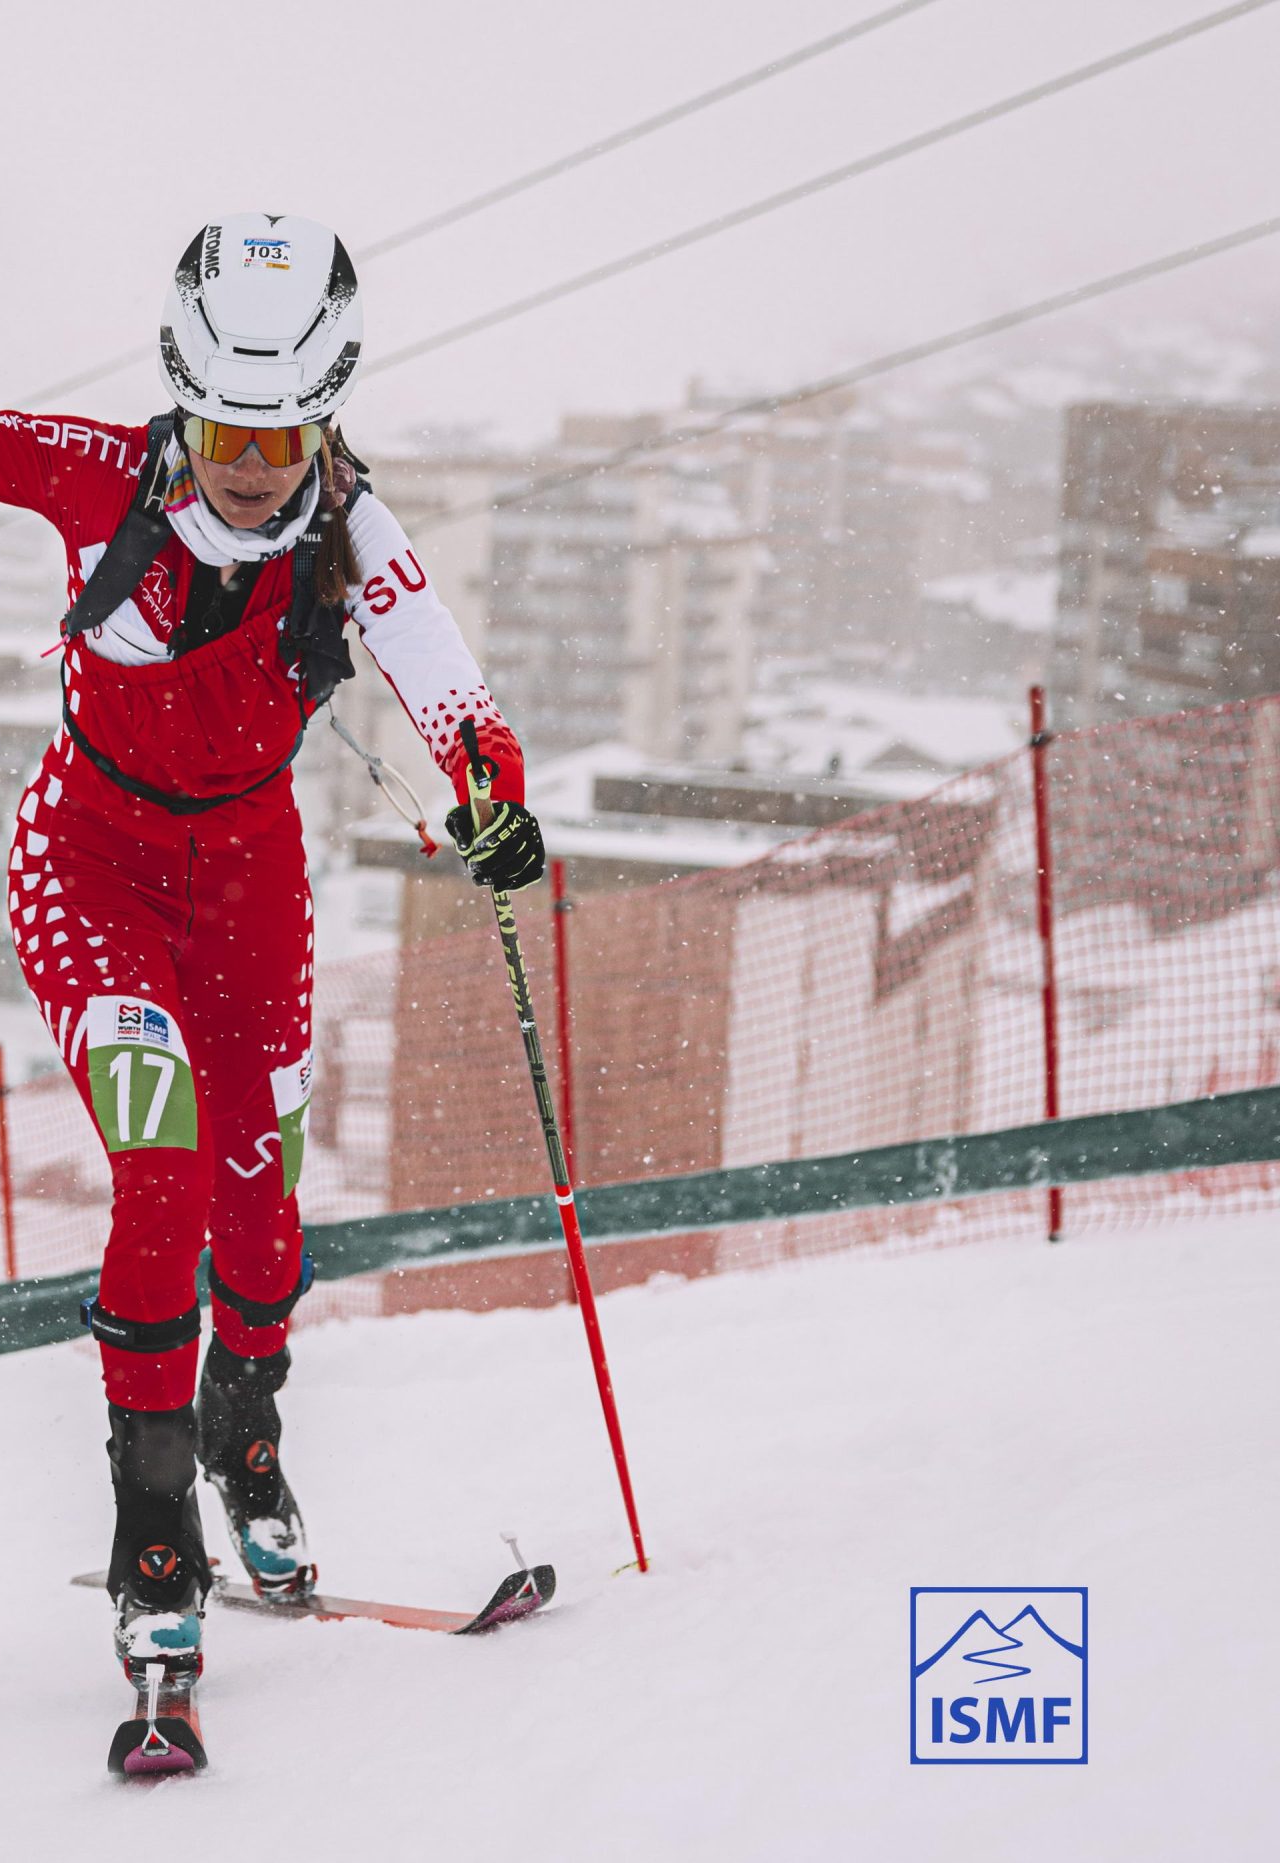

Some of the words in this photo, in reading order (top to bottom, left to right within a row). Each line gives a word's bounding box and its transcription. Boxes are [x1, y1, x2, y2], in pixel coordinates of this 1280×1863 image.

[204, 226, 222, 280] ATOMIC
[247, 246, 282, 259] 103
[486, 813, 523, 850] LEKI
[109, 1051, 175, 1142] 17
